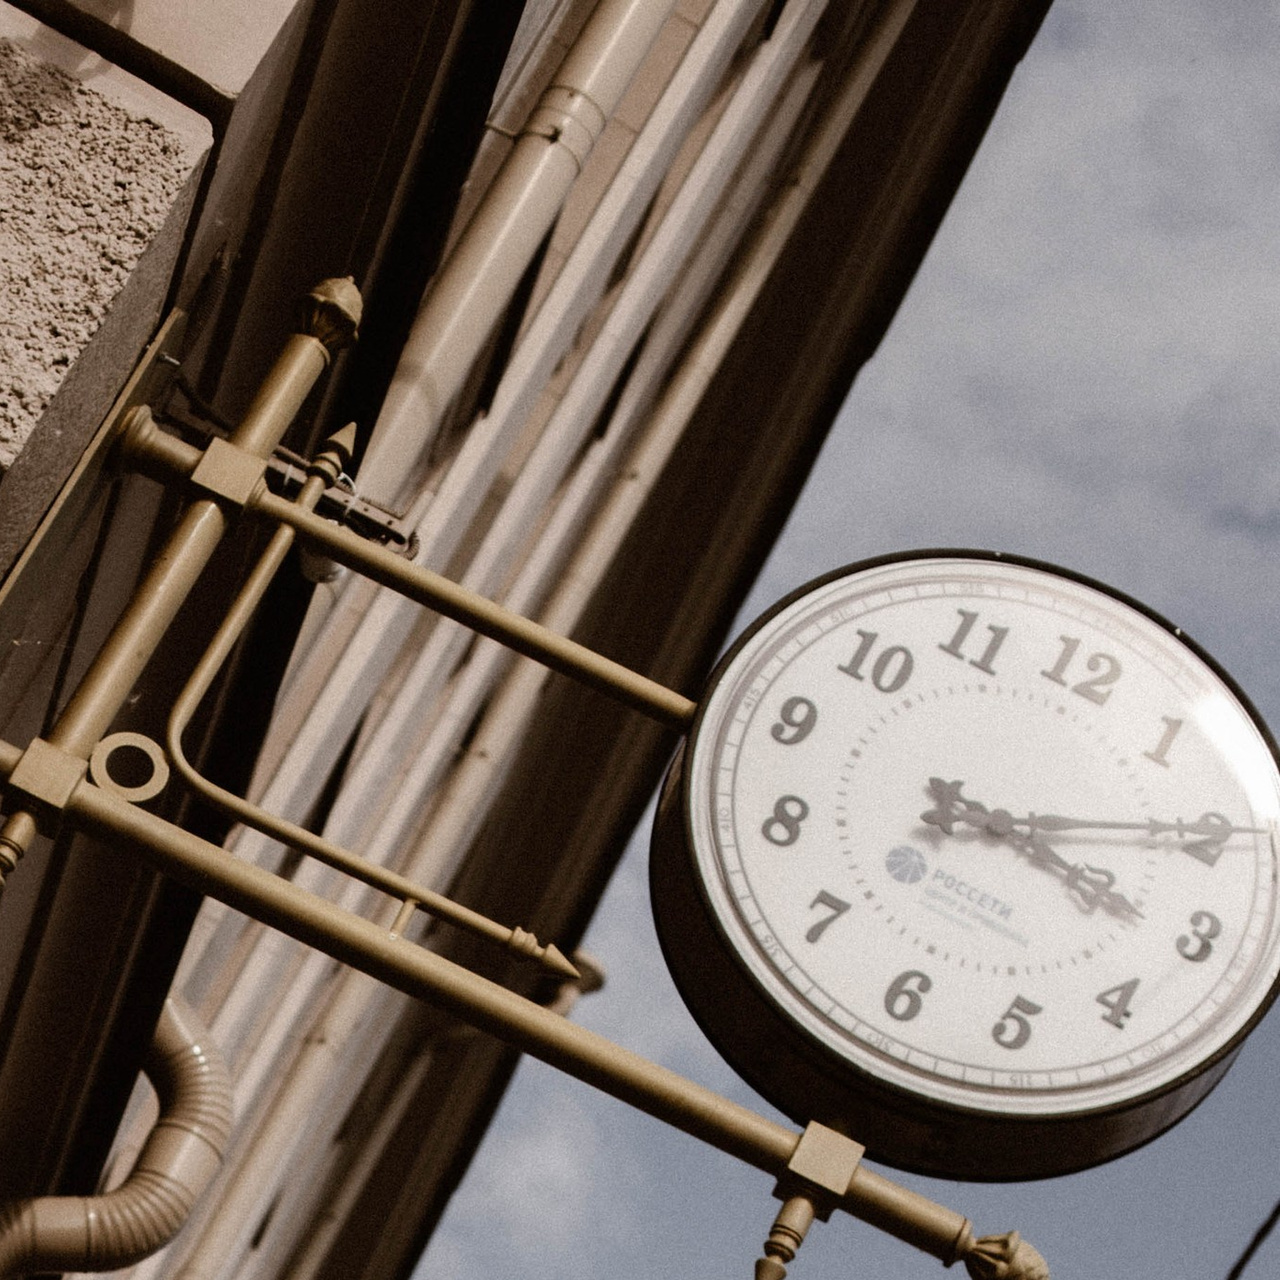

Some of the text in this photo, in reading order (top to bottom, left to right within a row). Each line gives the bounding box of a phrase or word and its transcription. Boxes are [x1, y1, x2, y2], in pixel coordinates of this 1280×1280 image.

[837, 627, 915, 694] 10
[937, 607, 1010, 676] 11
[1039, 633, 1123, 707] 12
[770, 694, 819, 746] 9
[1142, 715, 1183, 768] 1
[761, 794, 810, 848] 8
[805, 889, 852, 944] 7
[932, 868, 1014, 920] РОССЕТИ
[1175, 909, 1222, 963] 3
[883, 969, 933, 1022] 6
[991, 994, 1044, 1050] 5
[1095, 976, 1141, 1031] 4
